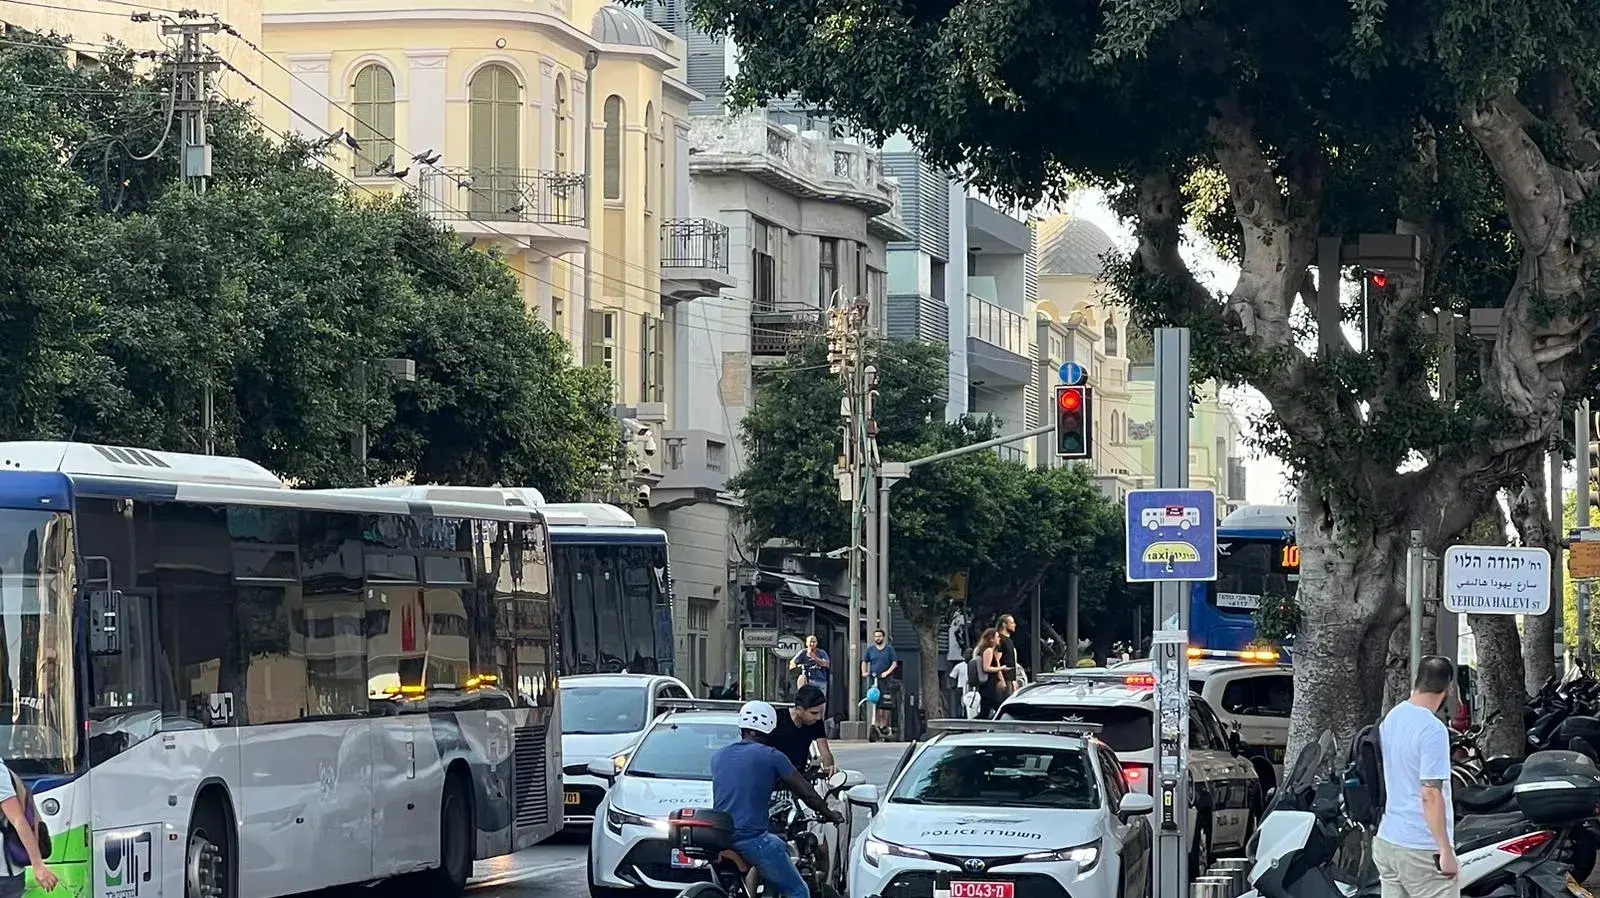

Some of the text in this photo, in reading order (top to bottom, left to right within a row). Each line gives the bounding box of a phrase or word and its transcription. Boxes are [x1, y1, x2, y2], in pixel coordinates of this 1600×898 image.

[1148, 548, 1169, 560] taxi
[1171, 552, 1196, 560] מוניו
[1454, 552, 1482, 568] הלוי
[1488, 556, 1525, 570] יהודה
[1450, 595, 1540, 609] YEHUDA HALEVI ST
[920, 829, 978, 838] POLICE
[983, 829, 1042, 840] משטרה
